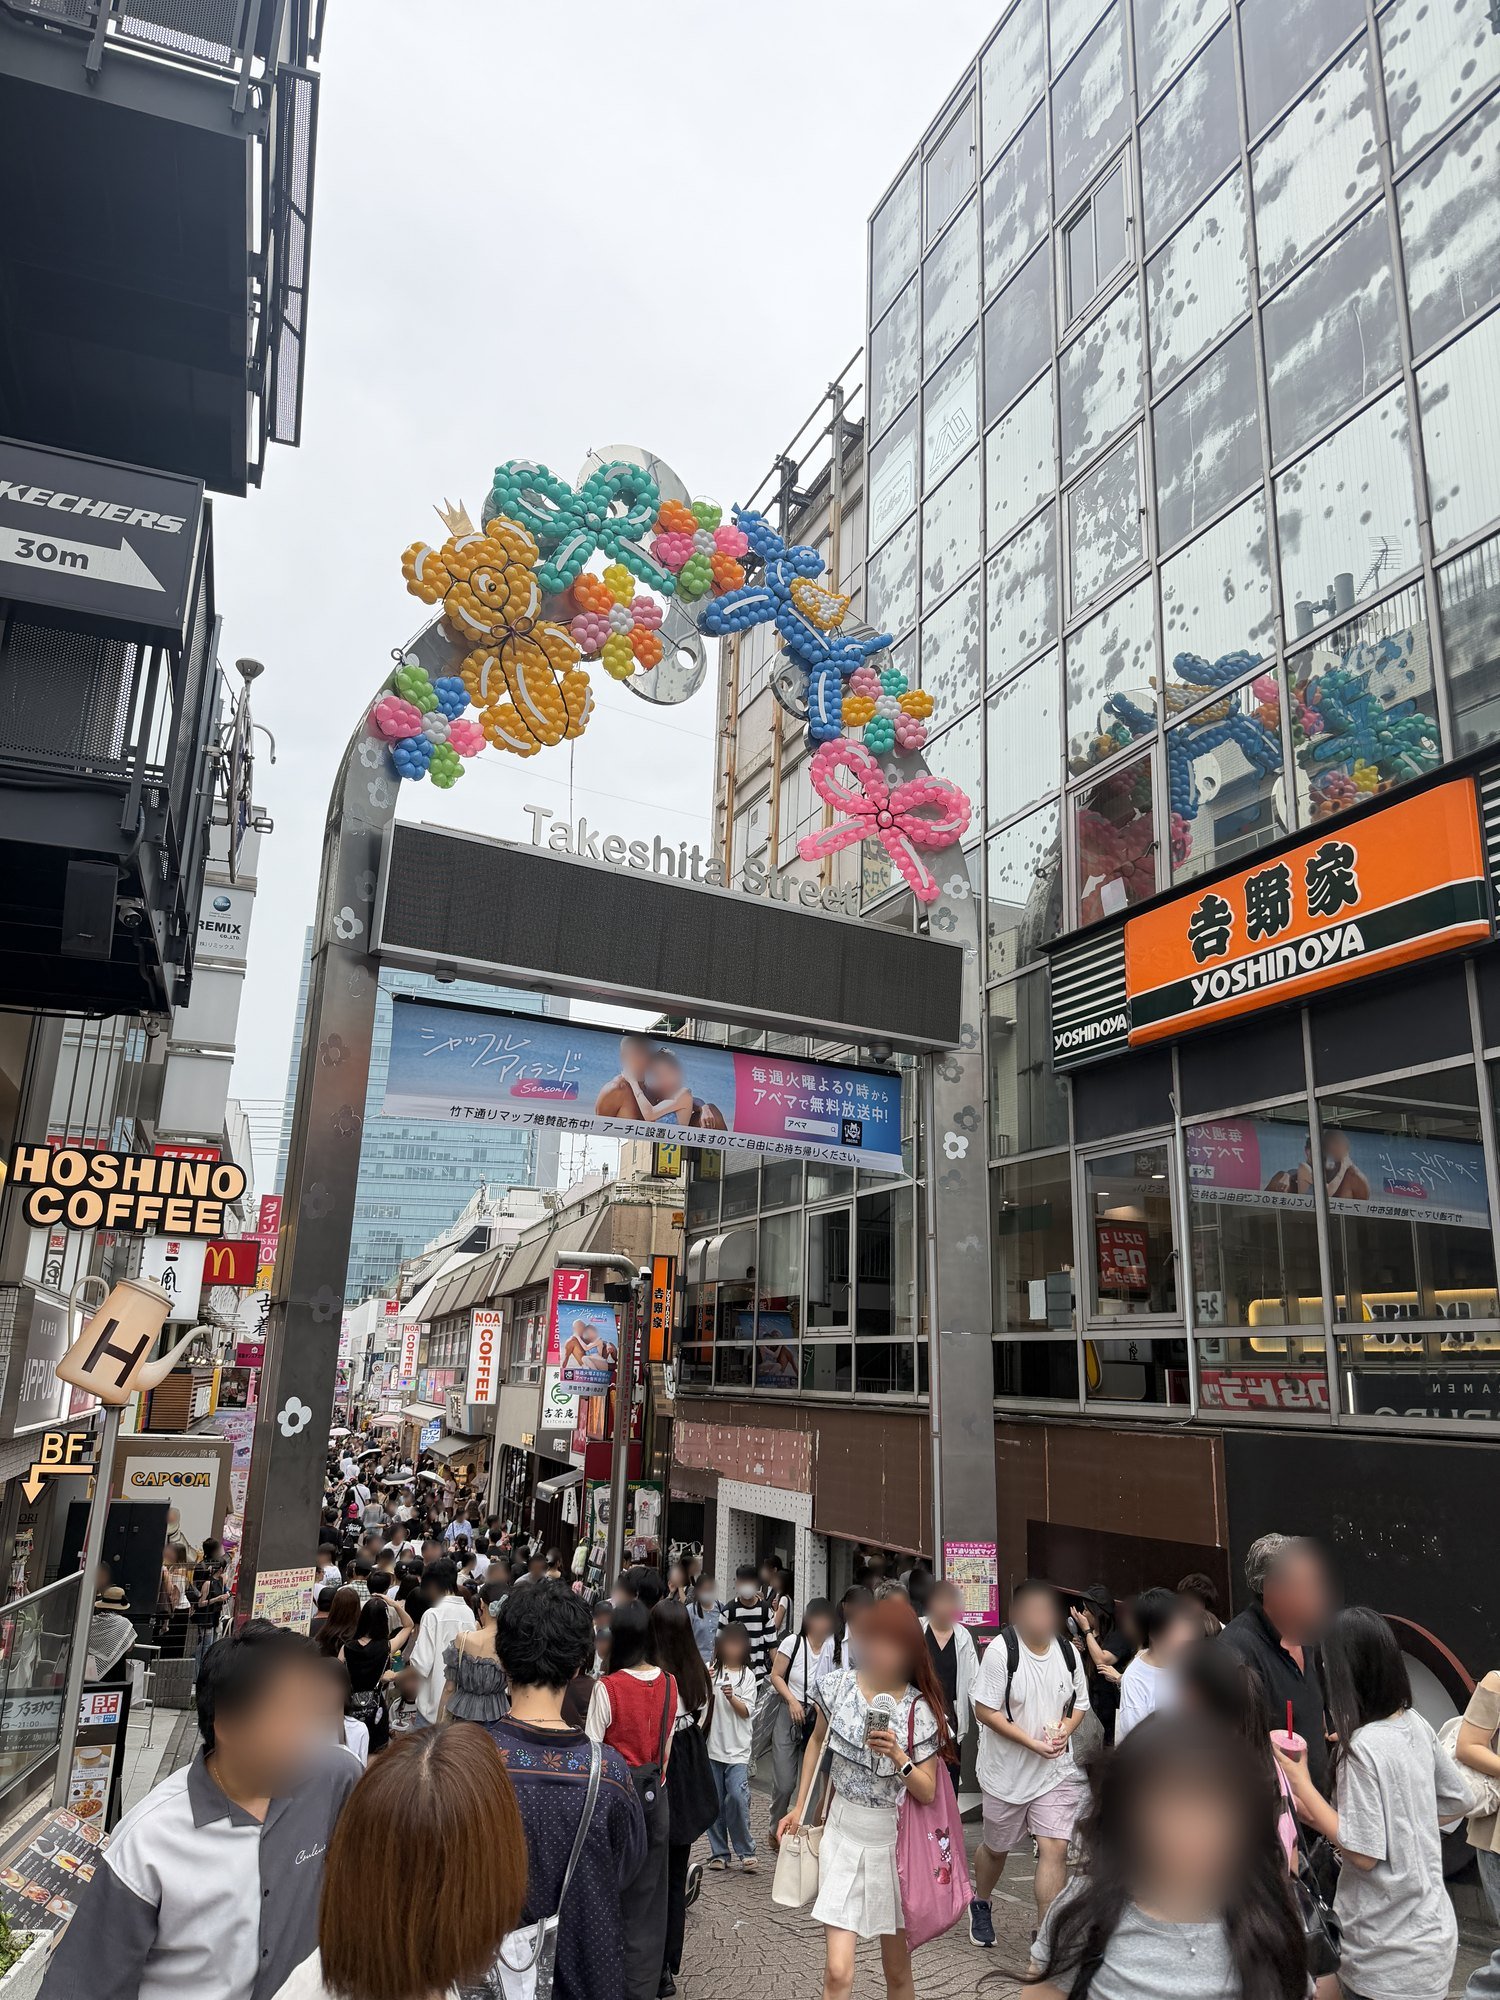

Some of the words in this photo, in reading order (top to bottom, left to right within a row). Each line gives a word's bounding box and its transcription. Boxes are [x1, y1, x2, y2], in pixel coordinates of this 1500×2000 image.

[14, 538, 89, 571] 30m
[523, 804, 727, 888] Takeshita
[742, 857, 858, 917] Street
[1188, 841, 1361, 965] 吉野家
[1191, 923, 1365, 1006] YOSHINOYA
[1054, 1013, 1128, 1051] YOSHINOYA
[482, 1049, 582, 1083] アイランド
[751, 1066, 889, 1104] 毎週火曜よる9時から
[787, 1119, 808, 1130] アベマ
[13, 1146, 244, 1200] HOSHINO
[29, 1186, 223, 1235] COFFEE
[253, 1293, 272, 1337] 古着
[475, 1312, 501, 1324] NOA
[652, 1287, 664, 1330] 吉野家
[404, 1324, 420, 1333] NOA
[82, 1318, 151, 1389] H
[403, 1334, 416, 1377] COFFEE
[474, 1328, 494, 1402] COFFEE
[543, 1408, 577, 1420] 吉茶庵
[40, 1433, 88, 1465] BF
[131, 1471, 210, 1488] CAPCOM
[257, 1577, 291, 1587] TAKESHITA
[291, 1574, 314, 1584] STREET
[95, 1695, 118, 1707] BF
